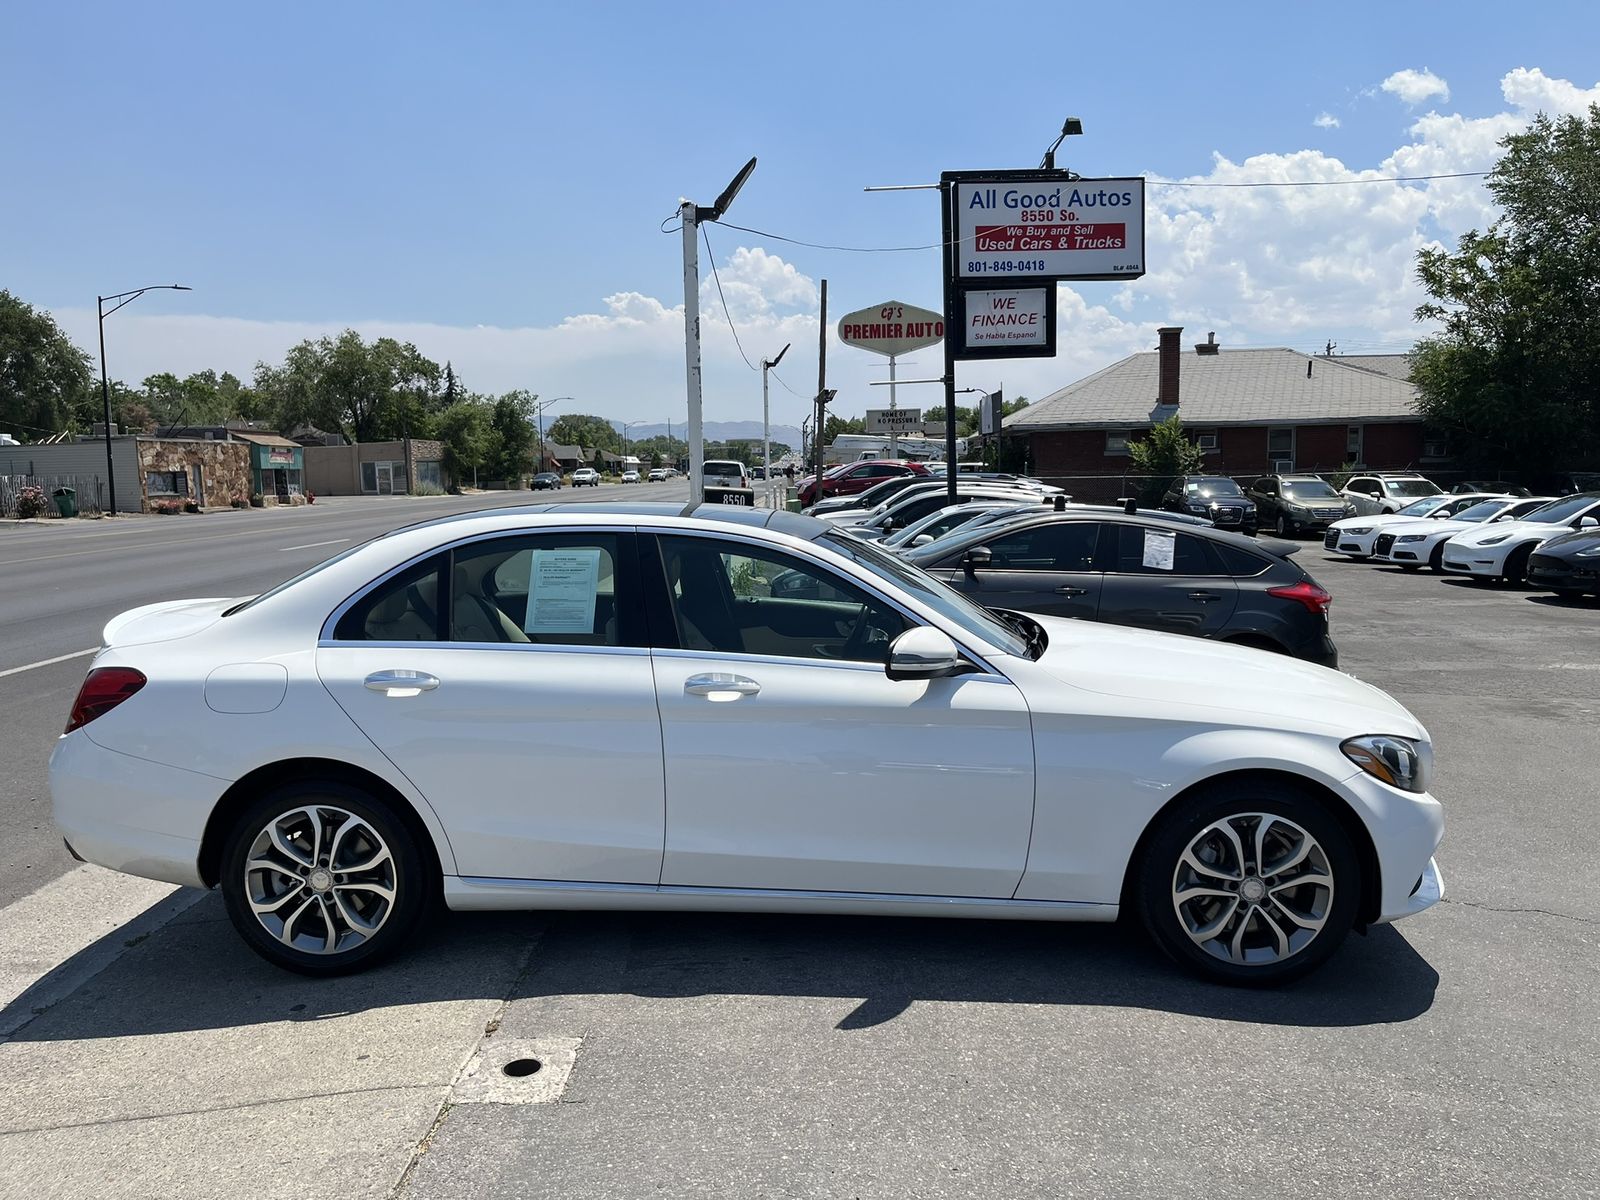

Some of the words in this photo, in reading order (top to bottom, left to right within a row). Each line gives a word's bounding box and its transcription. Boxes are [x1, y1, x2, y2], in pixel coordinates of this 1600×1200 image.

[969, 189, 996, 209] All
[1003, 188, 1060, 209] Good
[1067, 188, 1132, 208] Autos
[1021, 210, 1054, 222] 8550
[1059, 209, 1080, 222] So.
[1006, 226, 1023, 236] We
[1026, 225, 1047, 238] Buy
[1050, 225, 1070, 235] and
[1073, 225, 1094, 235] Sell
[979, 238, 1015, 250] Used
[1020, 237, 1052, 250] Cars
[1058, 236, 1068, 249] &
[1074, 236, 1122, 249] Trucks
[968, 260, 1045, 273] 801-849-0418
[993, 297, 1017, 310] WE
[972, 313, 1038, 327] FINANCE
[844, 324, 903, 339] PREMIER
[905, 321, 944, 338] AUTO
[985, 332, 1006, 340] Habla
[1007, 331, 1037, 340] Espanol
[723, 494, 745, 505] 8550
